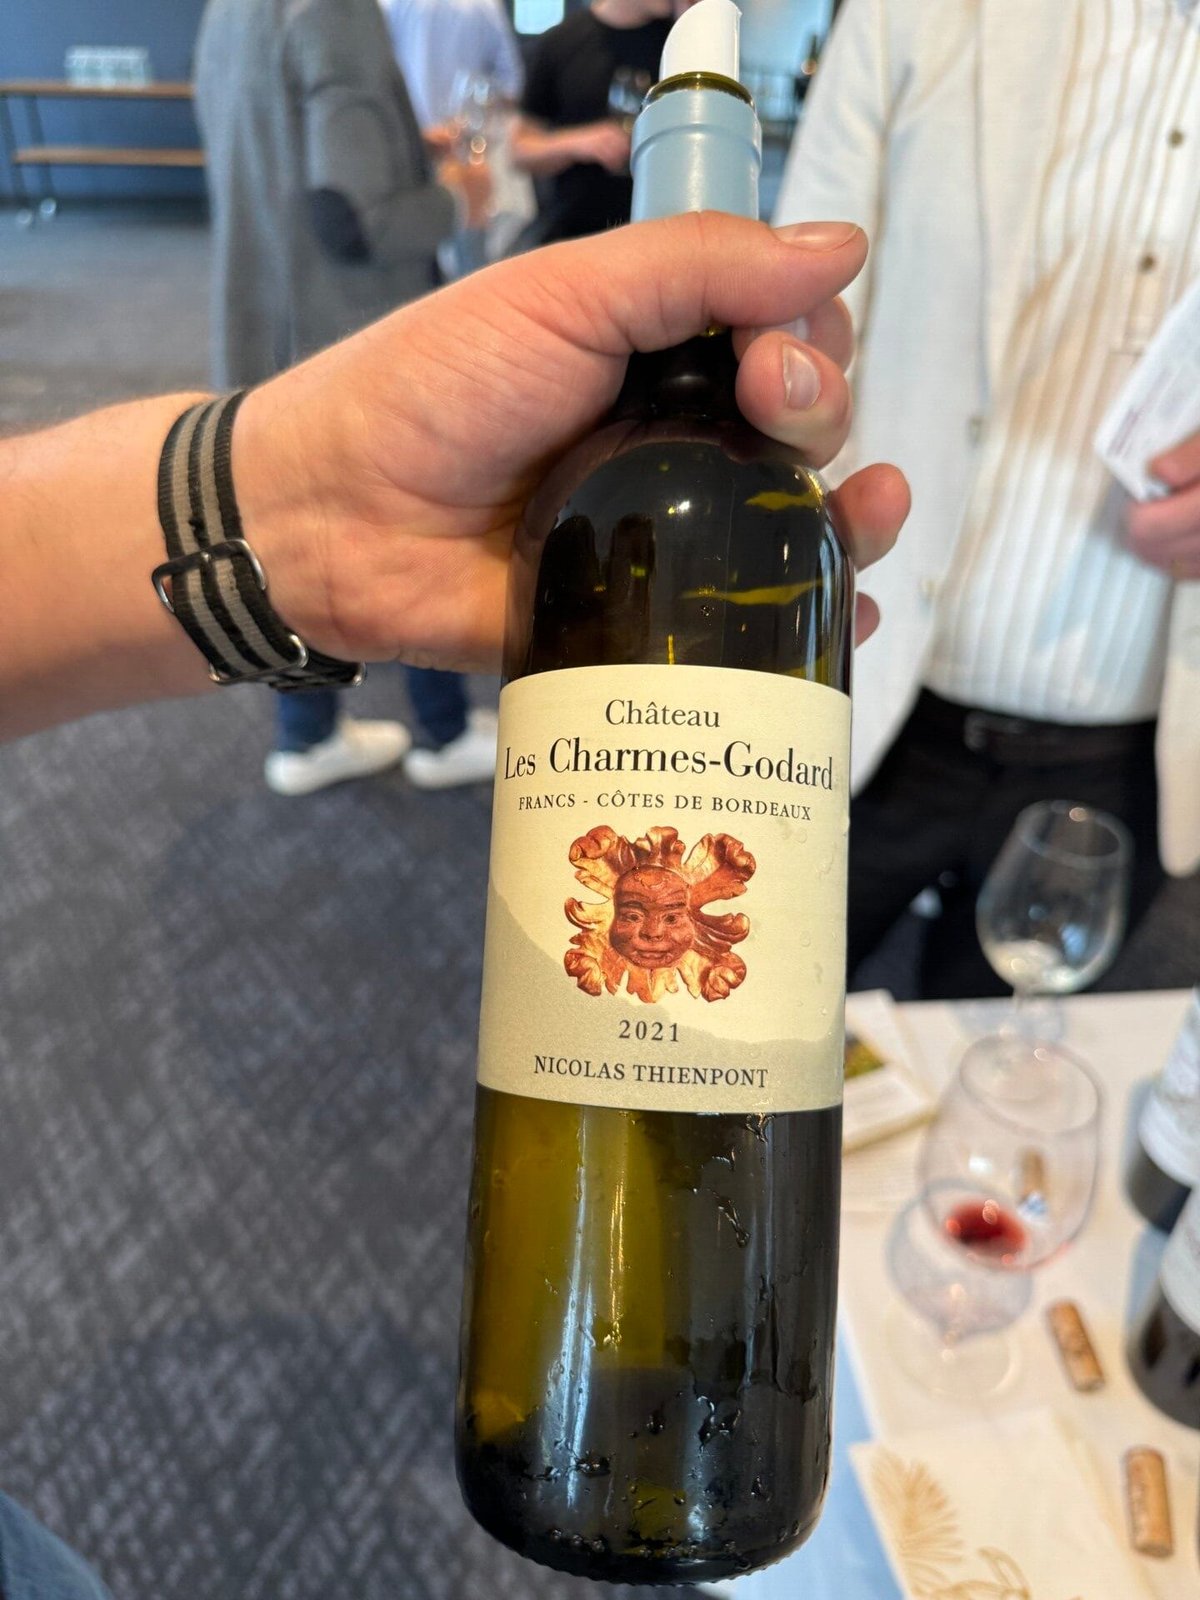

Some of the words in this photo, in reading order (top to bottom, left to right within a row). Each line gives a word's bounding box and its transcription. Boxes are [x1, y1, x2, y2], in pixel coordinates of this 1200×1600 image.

[605, 699, 720, 728] Château
[504, 746, 536, 780] Les
[549, 737, 834, 791] Charmes-Godard
[519, 793, 576, 811] FRANCS
[597, 789, 665, 809] CÔTES
[674, 795, 703, 810] DE
[712, 797, 812, 821] BORDEAUX
[618, 1019, 680, 1043] 2021
[534, 1055, 626, 1081] NICOLAS
[633, 1064, 769, 1089] THIENPONT
